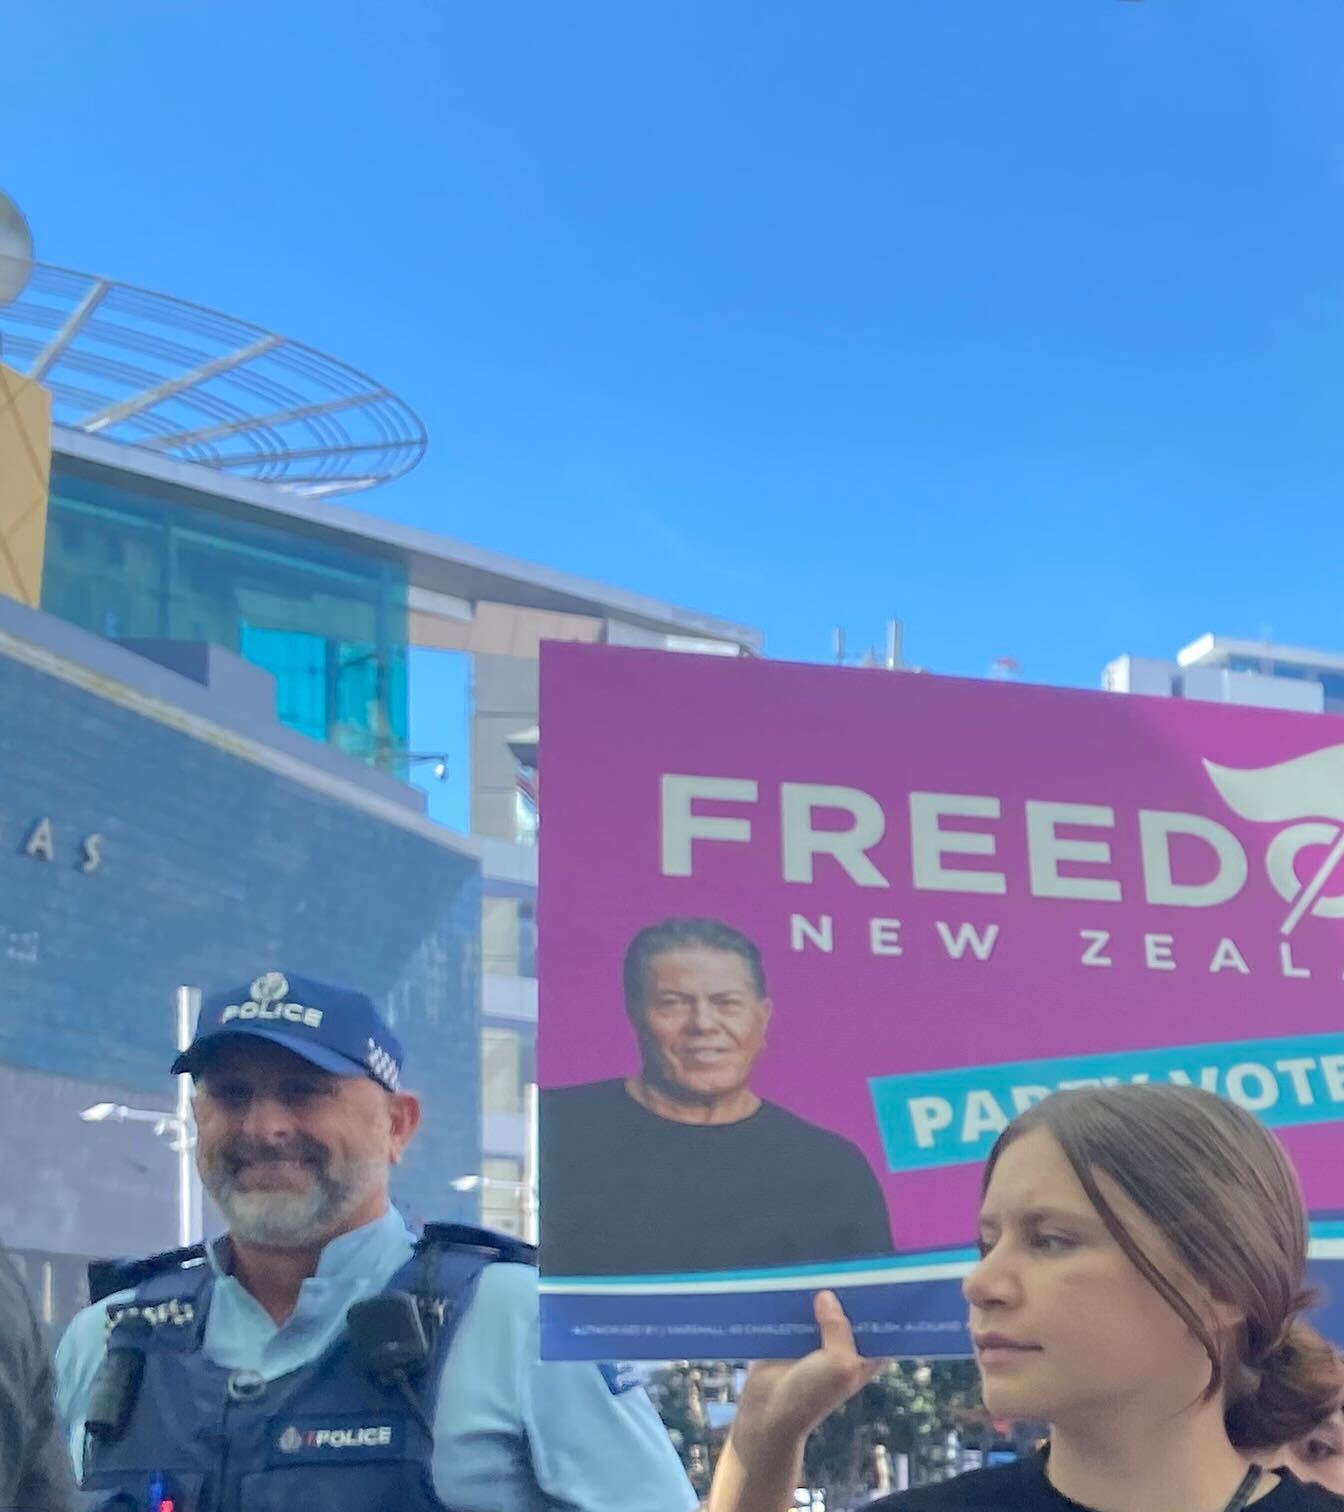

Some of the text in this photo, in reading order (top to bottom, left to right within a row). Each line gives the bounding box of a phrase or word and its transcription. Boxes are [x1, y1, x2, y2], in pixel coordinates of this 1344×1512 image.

[790, 913, 999, 961] NEW
[221, 1001, 325, 1029] POLICE
[315, 1426, 392, 1449] POLICE
